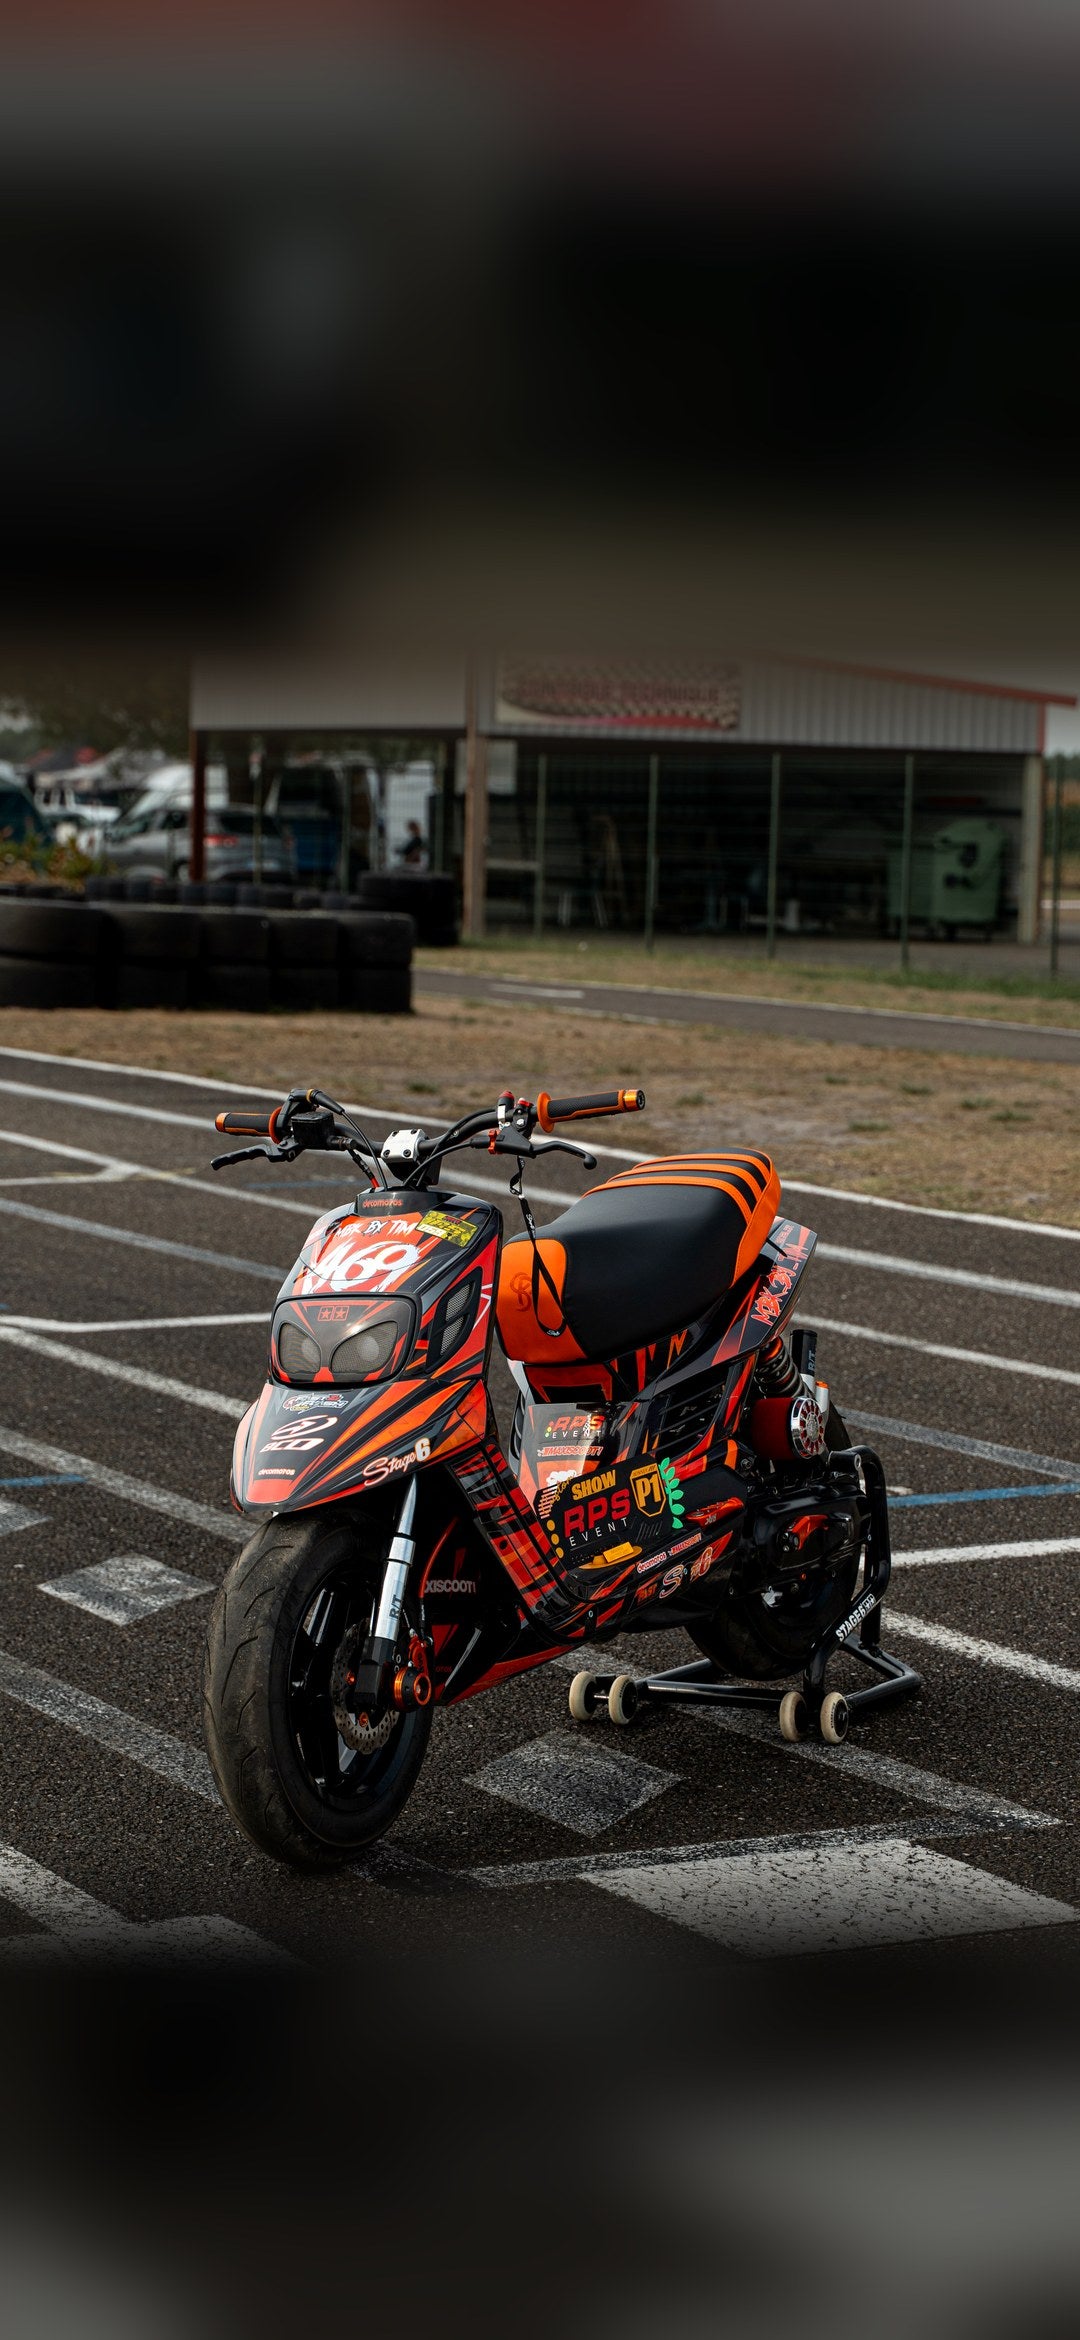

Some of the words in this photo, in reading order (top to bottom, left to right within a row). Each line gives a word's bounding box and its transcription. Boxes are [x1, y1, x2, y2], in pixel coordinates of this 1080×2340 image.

[336, 1222, 364, 1238] MBK
[362, 1219, 389, 1235] BY
[386, 1219, 419, 1237] TIM
[552, 1430, 602, 1439] EVENT
[362, 1437, 431, 1487] Stage6
[571, 1470, 616, 1501] SHOW
[636, 1478, 661, 1508] P1
[563, 1488, 631, 1538] RPS
[568, 1517, 628, 1547] EVENT
[424, 1579, 476, 1593] XISCOOT!
[388, 1594, 401, 1621] R/T
[835, 1603, 866, 1642] STAGE6
